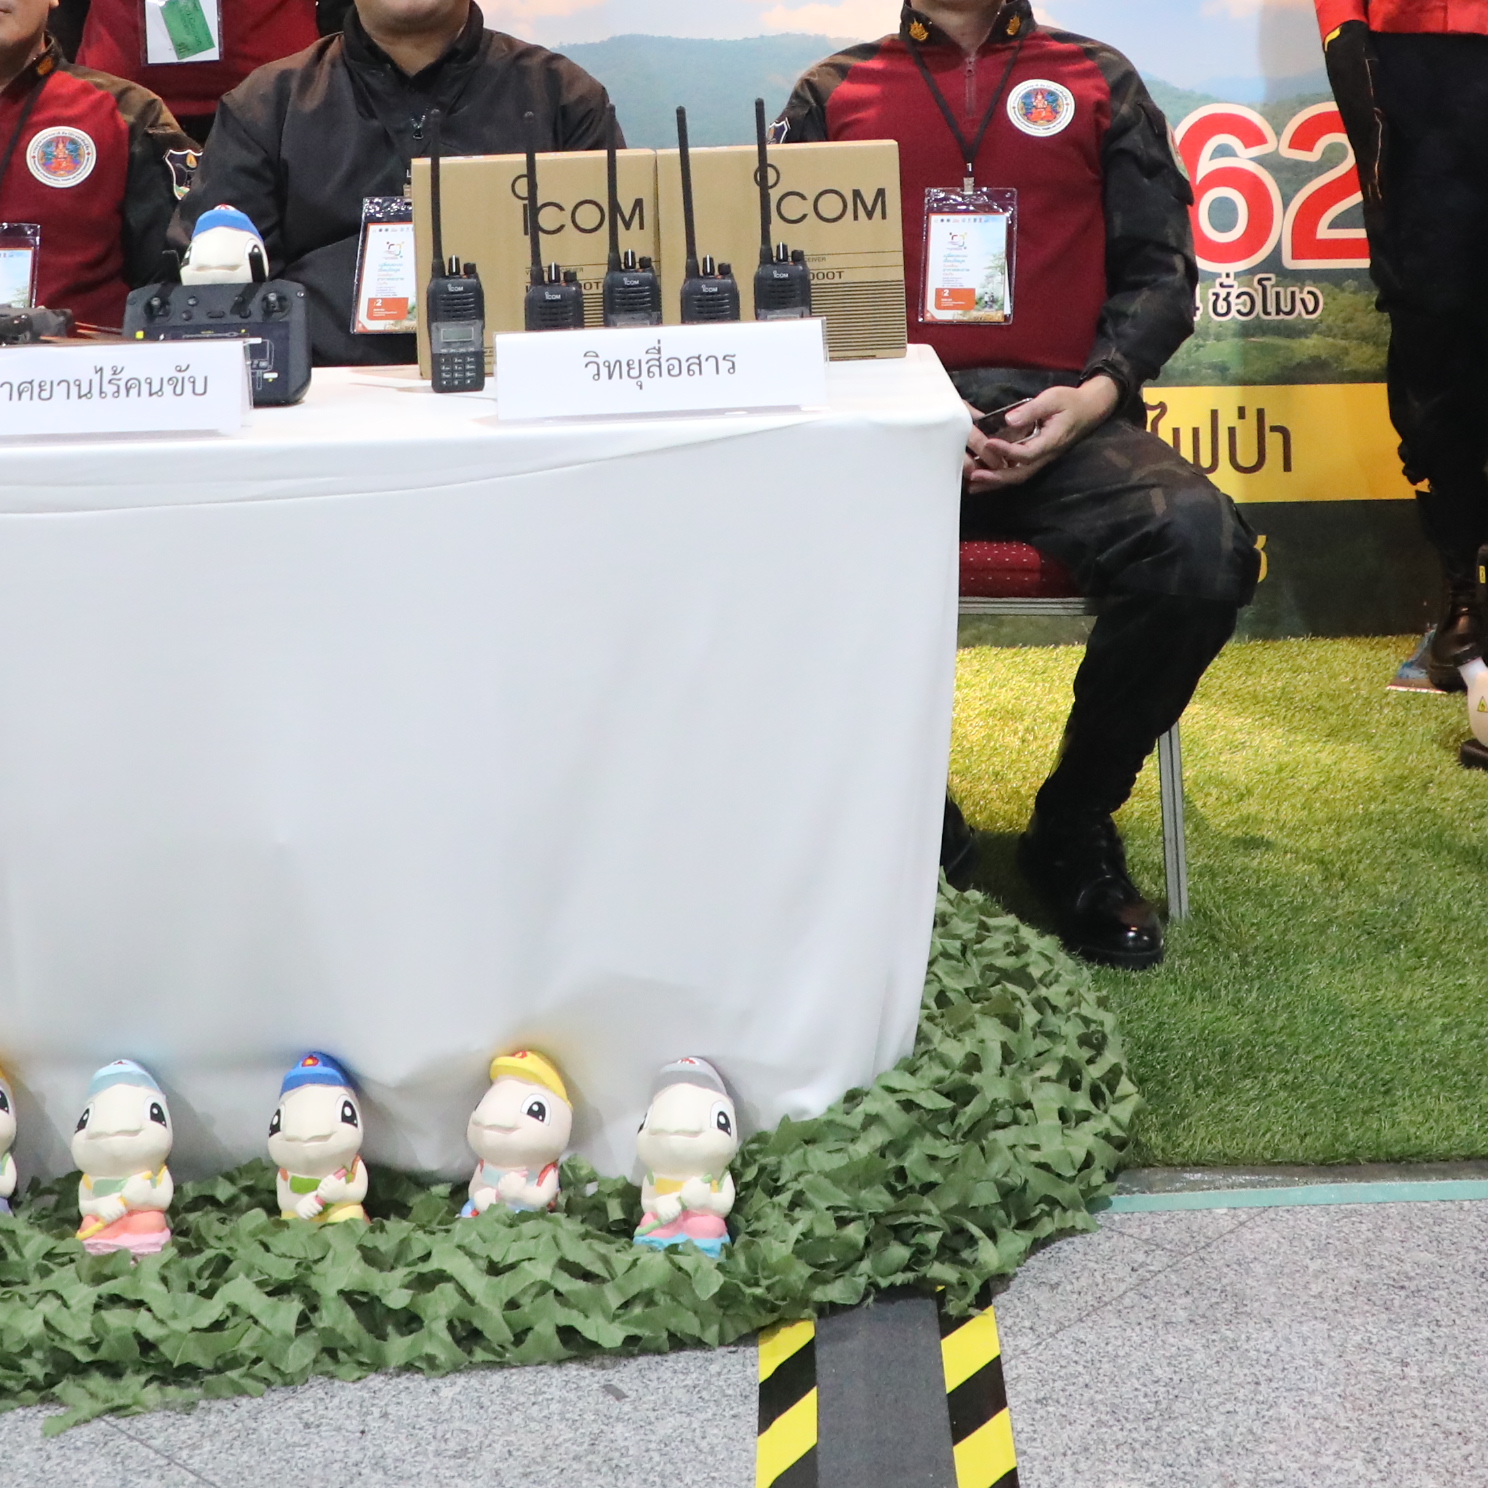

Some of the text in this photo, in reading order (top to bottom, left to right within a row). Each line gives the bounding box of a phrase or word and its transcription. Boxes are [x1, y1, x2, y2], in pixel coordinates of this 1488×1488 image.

[1211, 272, 1320, 318] ชั่วโมง
[582, 339, 737, 391] วิทยุสื่อสาร
